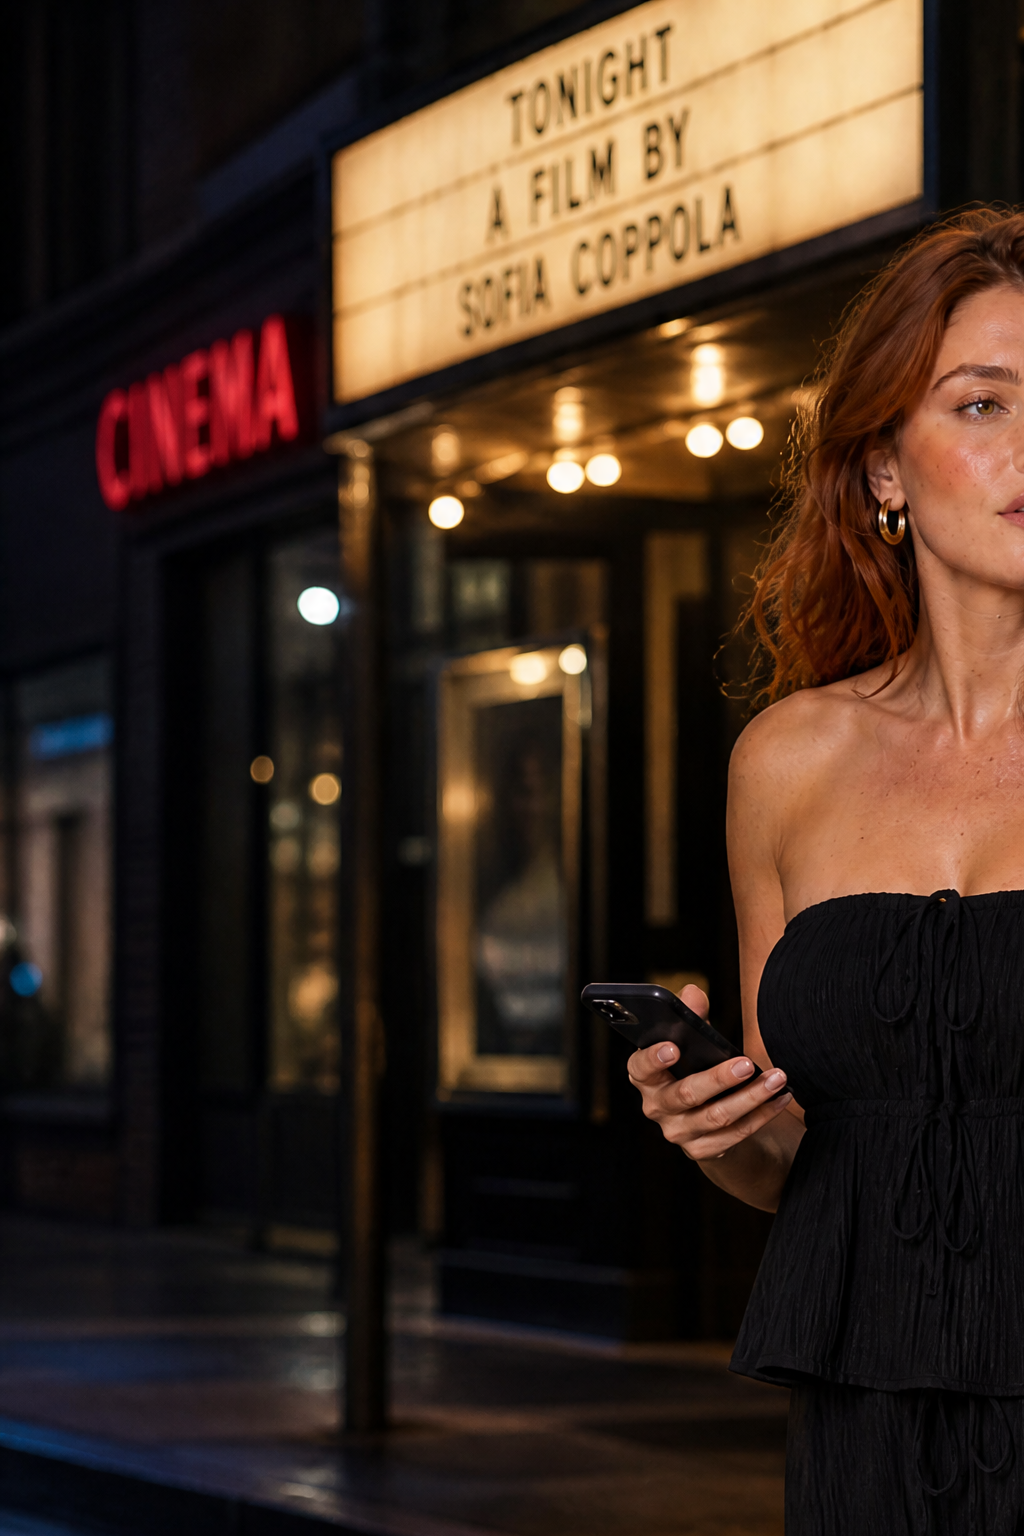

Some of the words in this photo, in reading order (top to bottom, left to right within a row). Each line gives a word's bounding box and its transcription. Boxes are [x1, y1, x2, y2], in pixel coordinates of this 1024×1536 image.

[508, 24, 673, 146] TONIGHT
[487, 187, 508, 242] A
[528, 139, 617, 227] FILM
[643, 107, 691, 182] BY
[458, 258, 551, 337] SOFIA
[570, 187, 740, 296] COPPOLA
[96, 313, 299, 510] CINEMA
